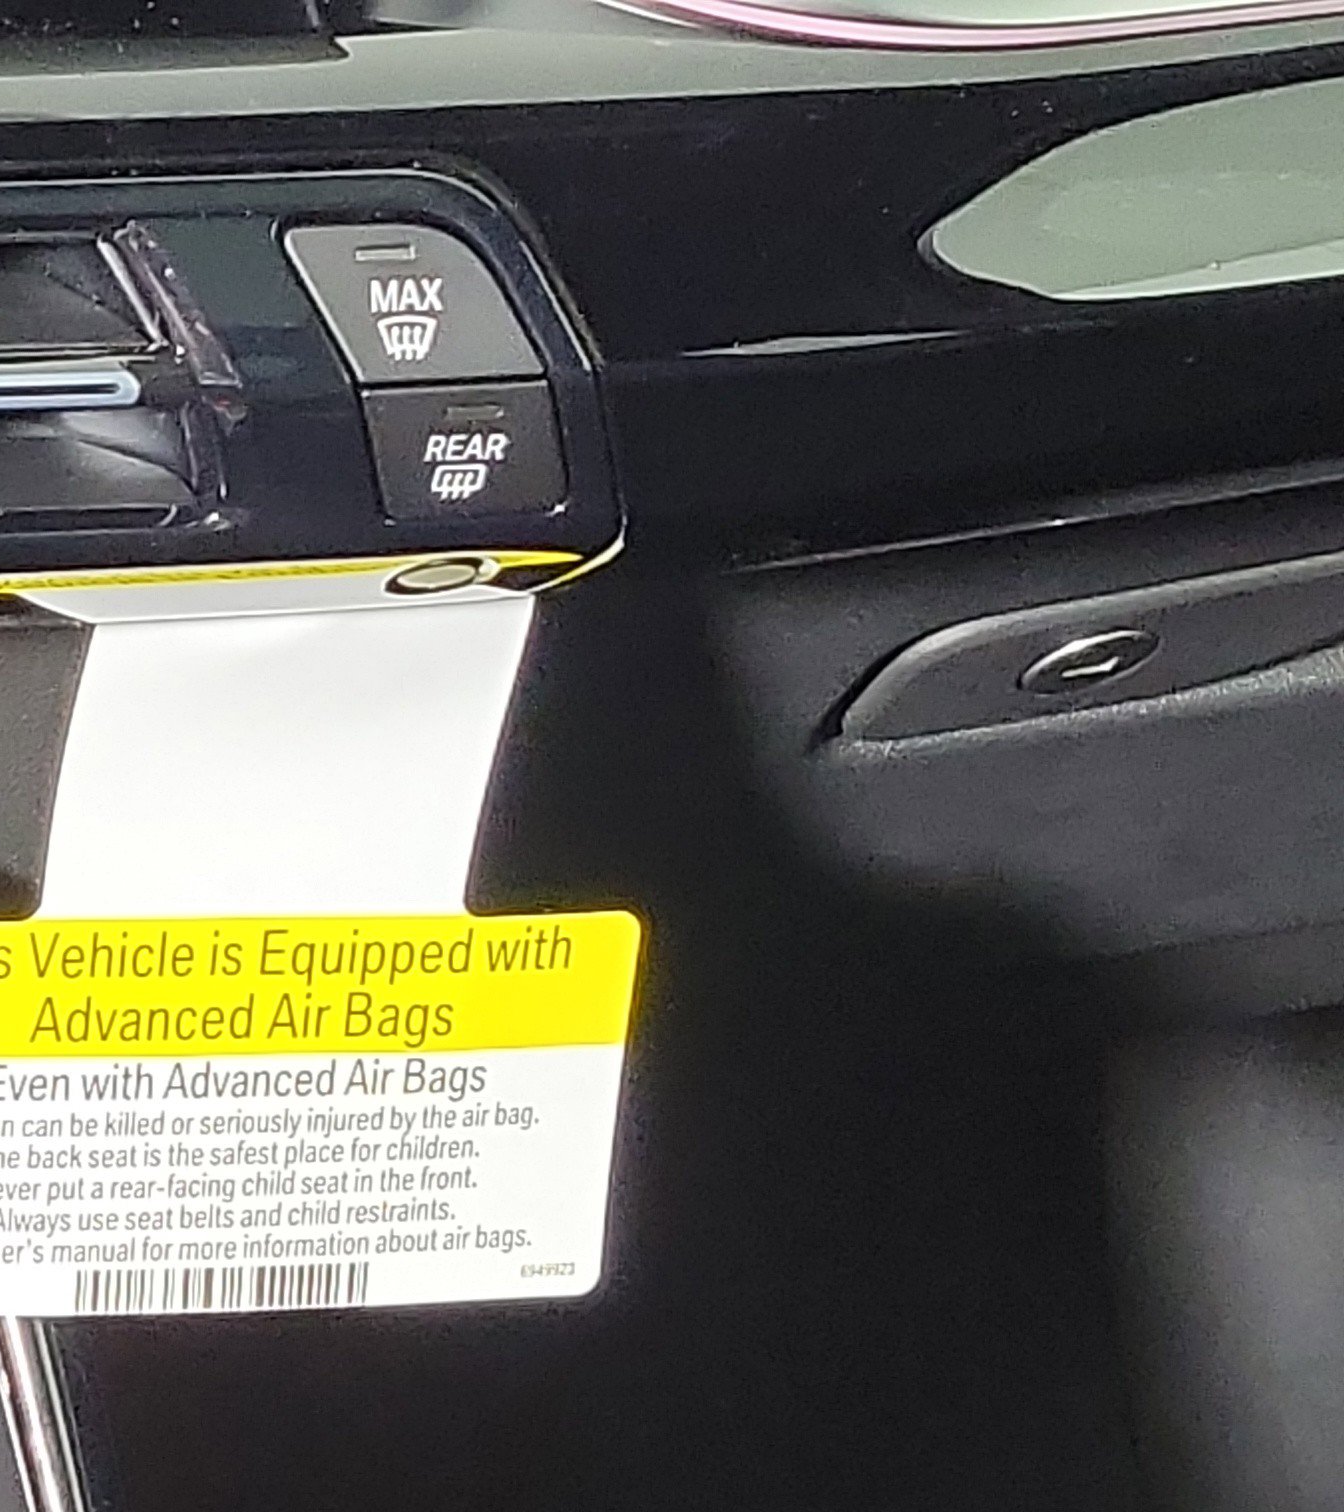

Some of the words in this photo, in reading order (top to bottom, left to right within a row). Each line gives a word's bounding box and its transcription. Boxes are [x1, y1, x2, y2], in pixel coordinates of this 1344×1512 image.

[370, 277, 443, 313] MAX
[423, 433, 509, 462] REAR
[29, 931, 194, 978] Vehicle
[210, 929, 243, 976] is
[260, 928, 474, 986] Equipped
[487, 924, 572, 972] with
[29, 994, 254, 1043] Advanced
[267, 993, 331, 1039] Air
[344, 992, 454, 1048] Bags
[82, 1062, 153, 1100] with
[162, 1059, 336, 1100] Advanced
[344, 1058, 394, 1095] Air
[403, 1058, 487, 1102] Bags
[21, 1118, 62, 1138] can
[69, 1113, 98, 1137] be
[104, 1111, 164, 1136] killed
[171, 1115, 194, 1136] or
[199, 1108, 301, 1138] seriously
[307, 1106, 383, 1139] injured
[390, 1106, 417, 1140] by
[423, 1104, 456, 1129] the
[462, 1103, 490, 1127] air
[494, 1101, 539, 1130] bag.
[27, 1144, 82, 1168] back
[88, 1145, 137, 1167] seat
[143, 1142, 161, 1167] is
[168, 1142, 204, 1167] the
[209, 1139, 278, 1166] safest
[283, 1138, 344, 1170] place
[350, 1137, 380, 1162] for
[386, 1133, 480, 1161] children.
[47, 1177, 84, 1206] put
[91, 1180, 103, 1199] a
[111, 1172, 235, 1202] rear-facing
[241, 1170, 295, 1197] child
[300, 1171, 348, 1195] seat
[353, 1169, 373, 1193] in
[379, 1166, 414, 1192] the
[419, 1166, 477, 1190] front.
[78, 1211, 118, 1231] use
[124, 1208, 173, 1230] seat
[179, 1204, 234, 1229] belts
[240, 1202, 281, 1227] and
[287, 1201, 340, 1226] child
[346, 1198, 455, 1224] restraints.
[51, 1238, 135, 1263] manual
[142, 1236, 173, 1261] for
[178, 1240, 237, 1261] more
[243, 1232, 369, 1258] information
[375, 1228, 437, 1254] about
[444, 1226, 470, 1250] air
[475, 1226, 532, 1254] bags.
